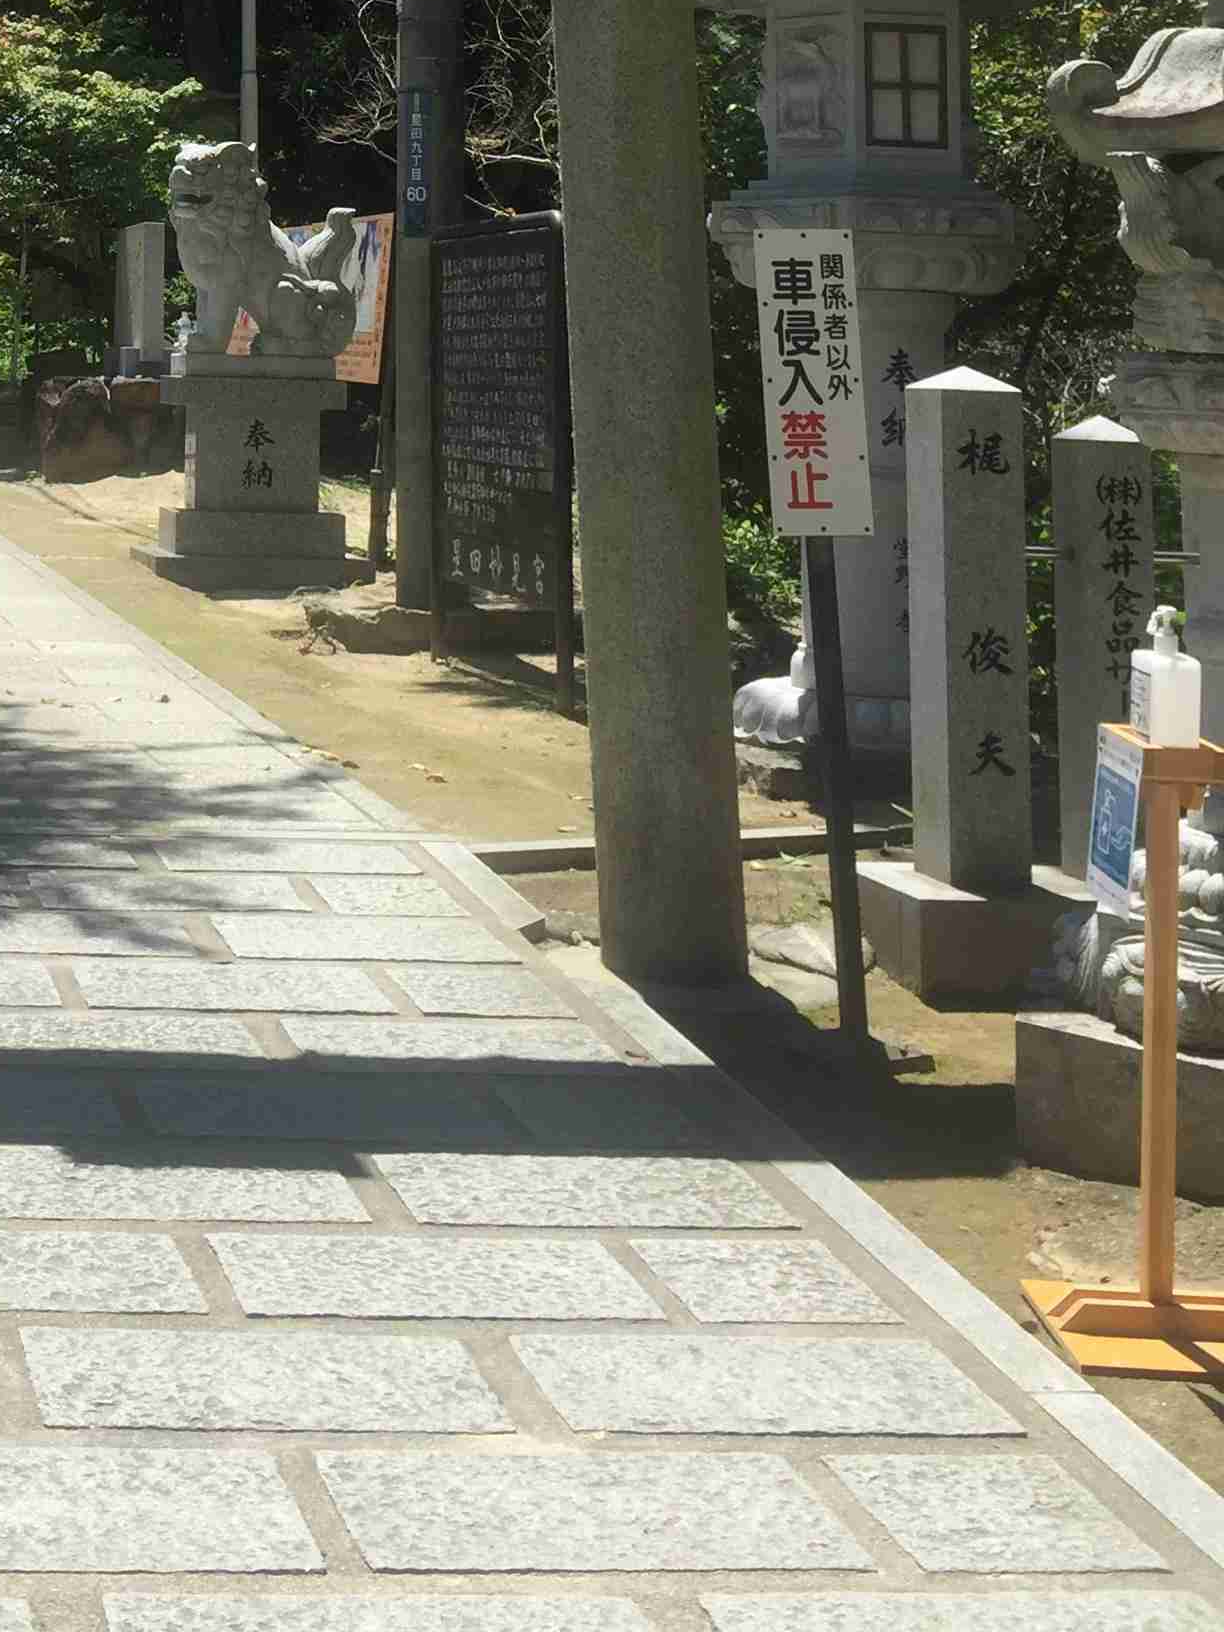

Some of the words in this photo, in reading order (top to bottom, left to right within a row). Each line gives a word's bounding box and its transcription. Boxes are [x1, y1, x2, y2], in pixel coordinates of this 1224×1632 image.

[407, 186, 427, 202] 60
[820, 254, 854, 402] 関係者以外
[771, 257, 834, 510] 車侵入禁止
[241, 419, 276, 490] 奉納
